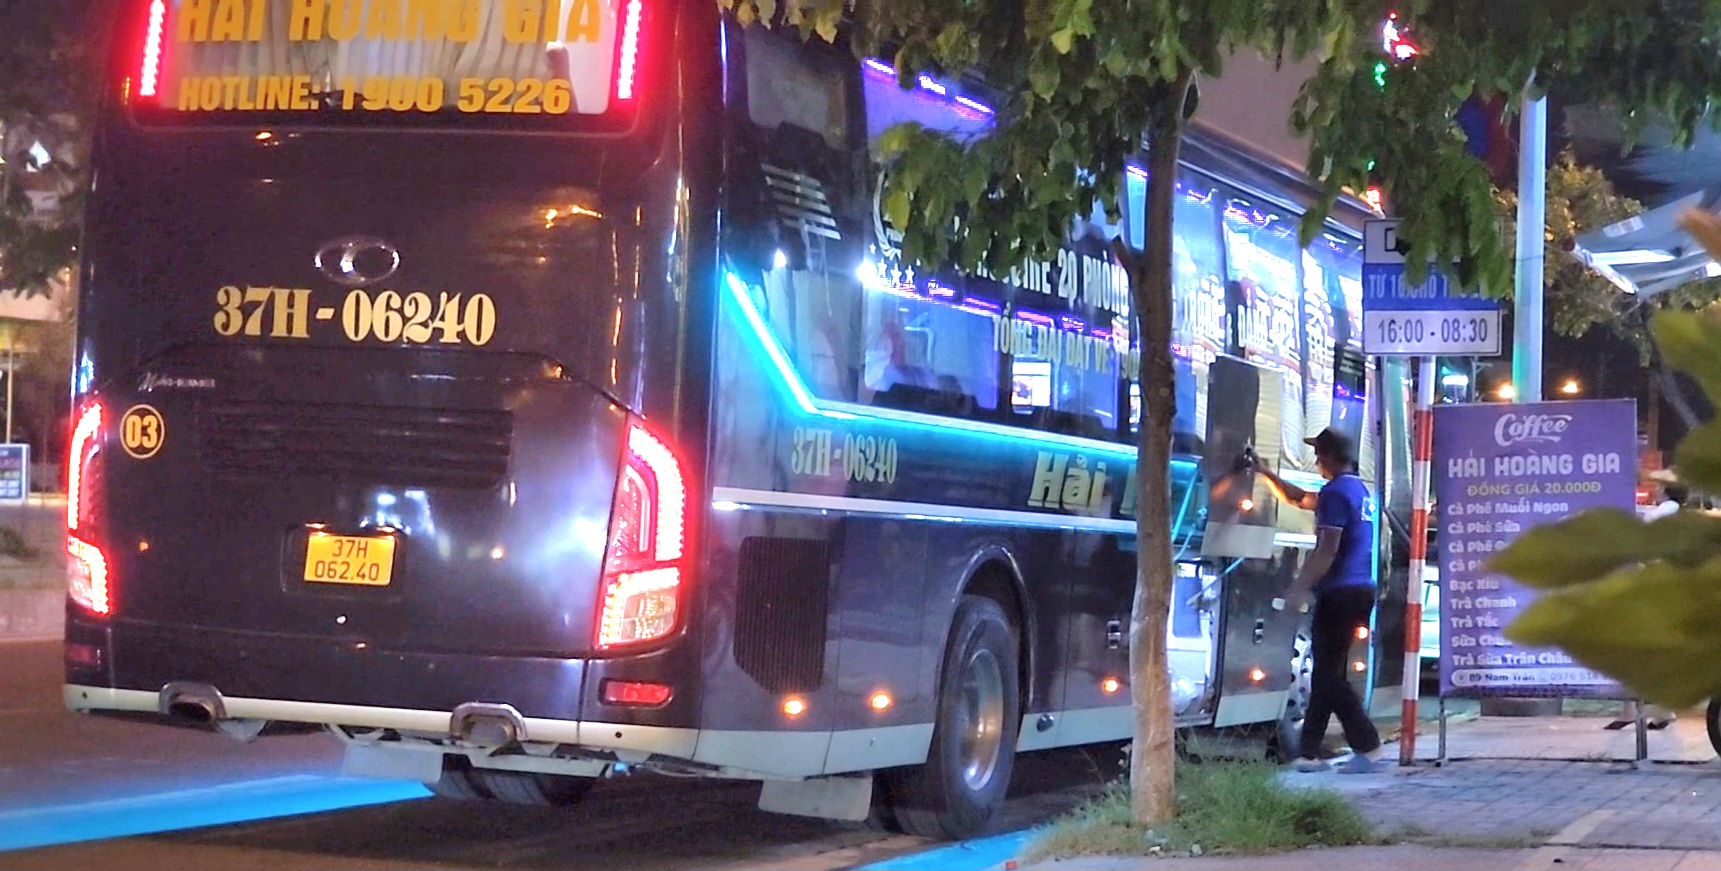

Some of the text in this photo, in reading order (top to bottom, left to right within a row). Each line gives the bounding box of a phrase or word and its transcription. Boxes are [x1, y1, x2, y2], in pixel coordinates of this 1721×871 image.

[179, 76, 570, 114] HOTLINE: 1900 5226
[1378, 319, 1424, 344] 16:00
[1441, 318, 1488, 342] 08:30
[126, 415, 158, 448] 03
[1494, 413, 1573, 447] Coffee
[1448, 448, 1620, 478] HẢI HOÀNG GIA
[1027, 451, 1107, 512] Hải
[1514, 480, 1540, 495] GIÁ
[1533, 502, 1569, 514] Ngon
[332, 539, 368, 559] 37H
[314, 560, 380, 582] 062.40
[1475, 596, 1517, 609] Chanh
